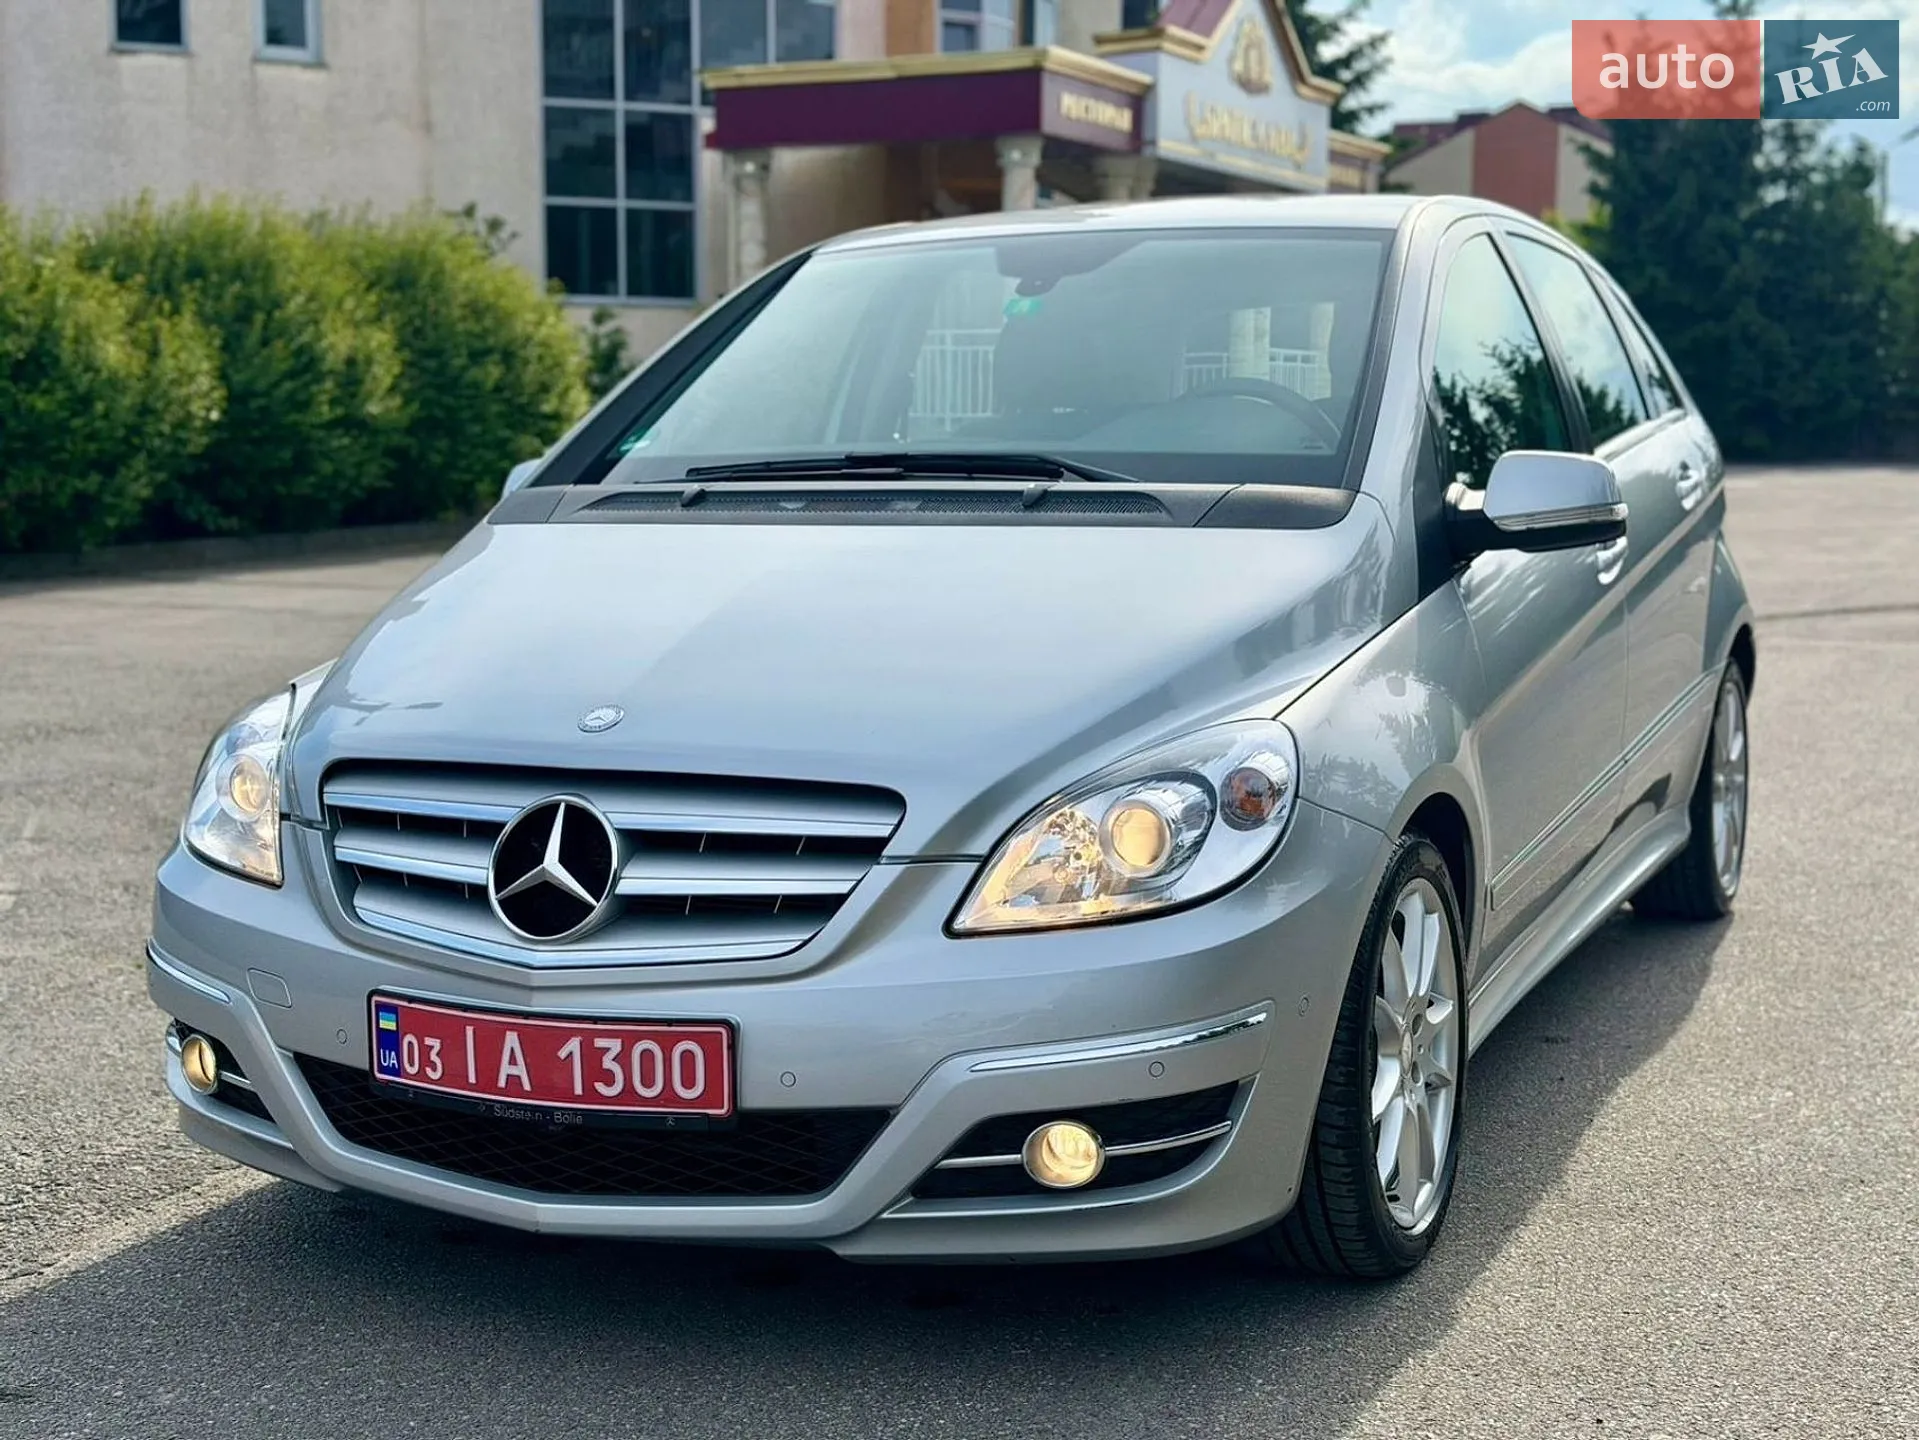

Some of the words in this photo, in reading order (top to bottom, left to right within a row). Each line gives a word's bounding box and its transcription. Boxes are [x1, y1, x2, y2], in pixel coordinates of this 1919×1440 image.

[380, 1047, 399, 1069] UA
[402, 1033, 444, 1080] 03
[557, 1036, 706, 1100] 1300
